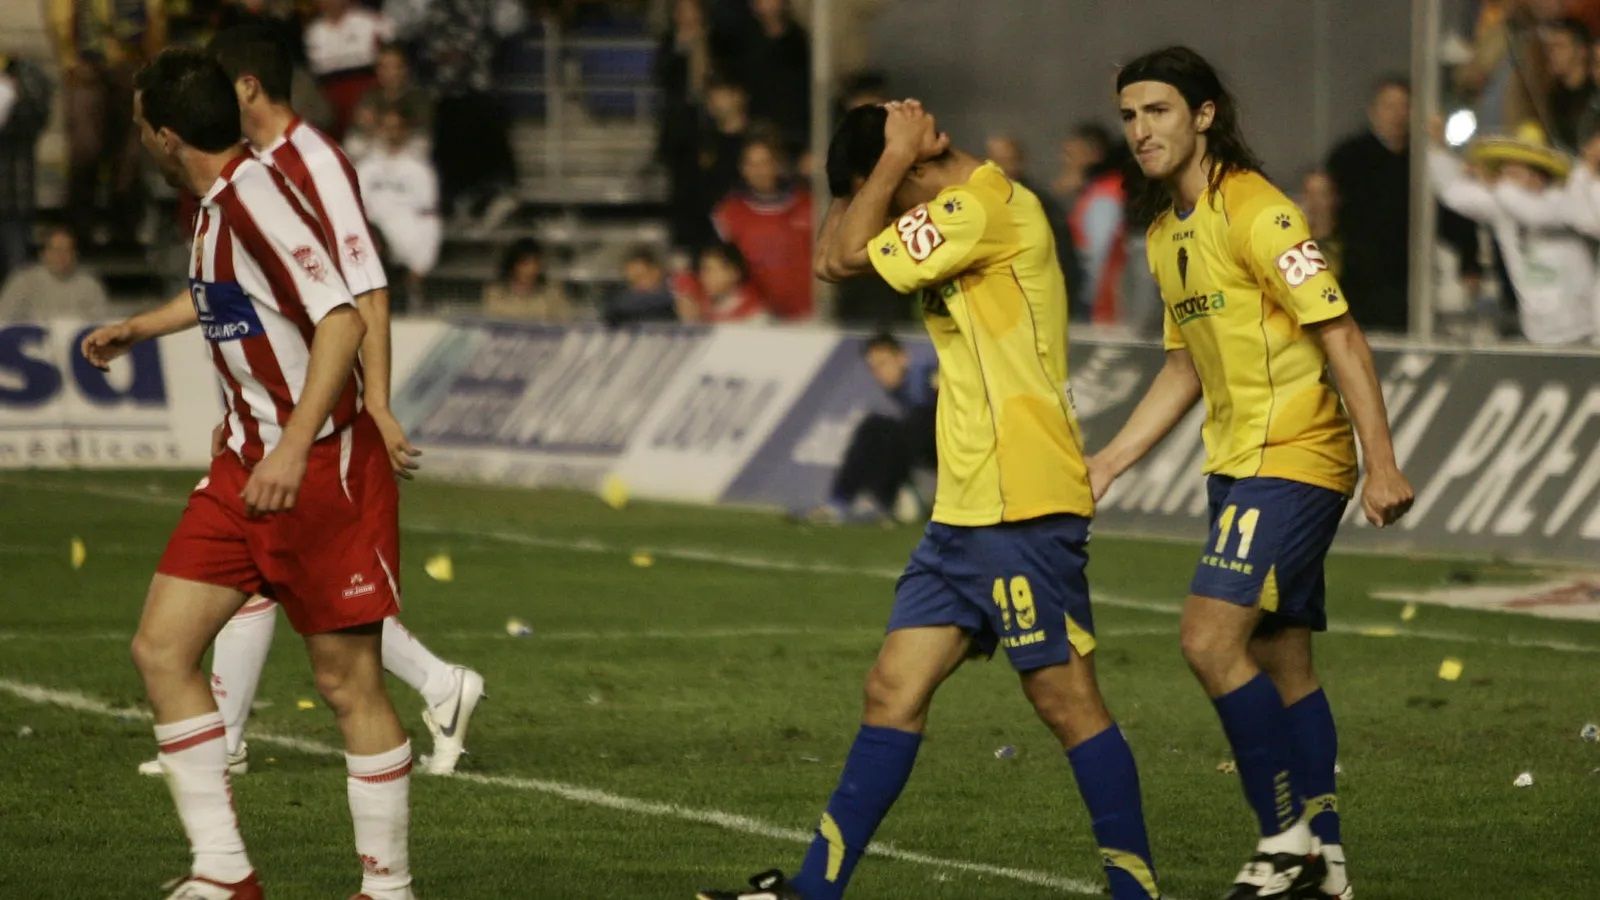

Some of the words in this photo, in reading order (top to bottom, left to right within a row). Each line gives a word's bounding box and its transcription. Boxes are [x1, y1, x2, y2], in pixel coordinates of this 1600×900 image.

[897, 207, 943, 261] as
[1279, 241, 1328, 285] as
[1214, 504, 1260, 560] 11
[992, 575, 1036, 630] 19
